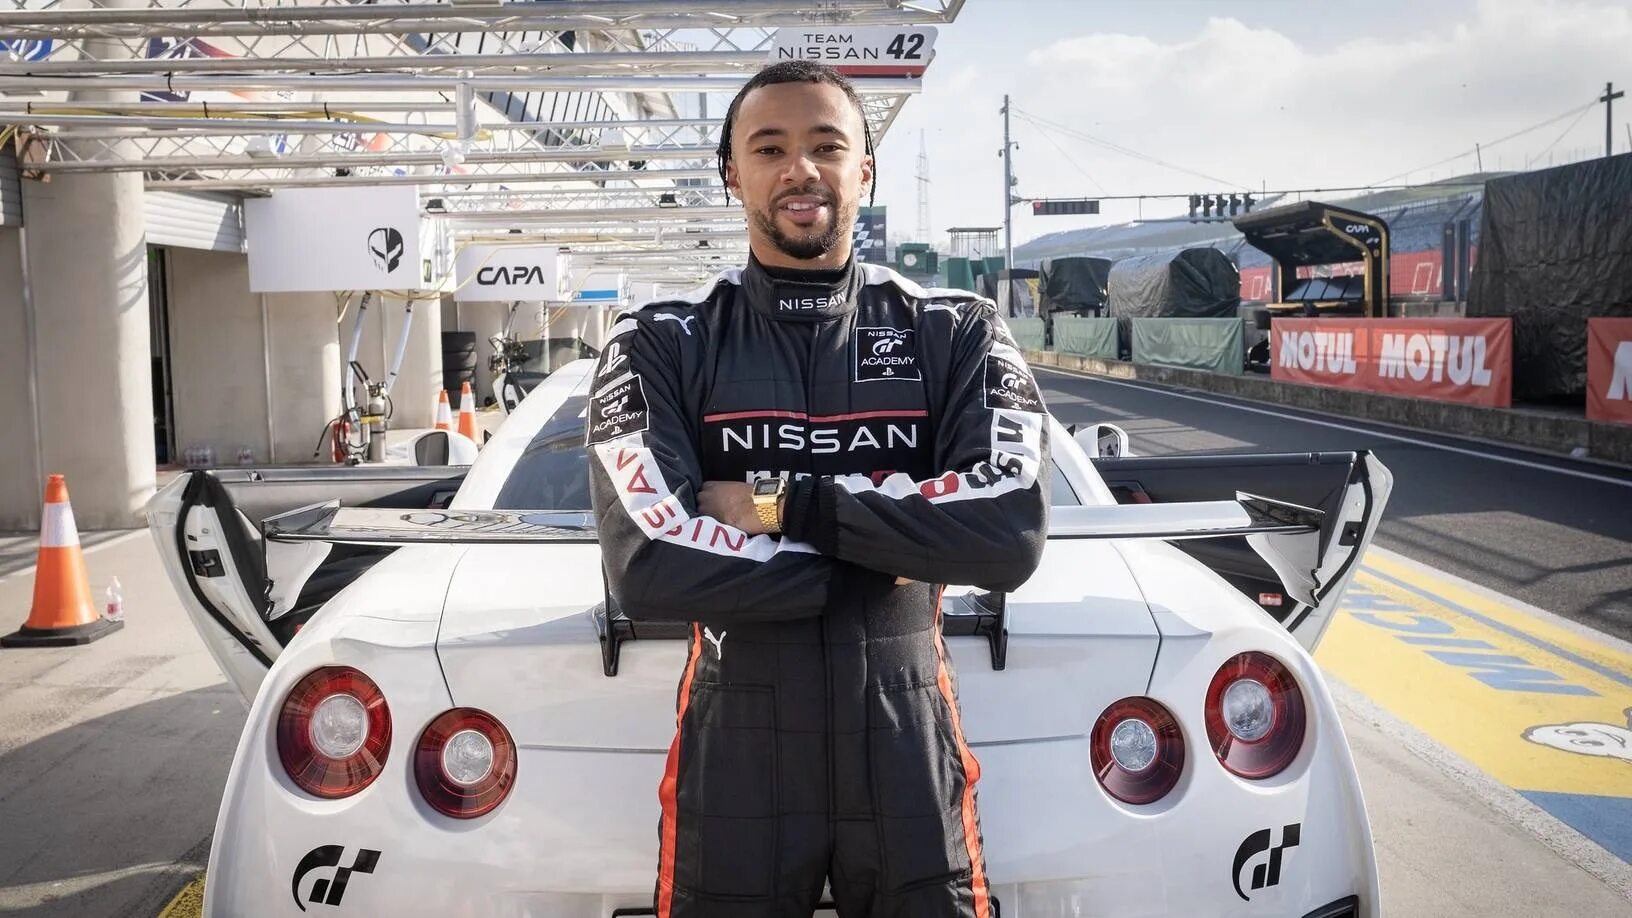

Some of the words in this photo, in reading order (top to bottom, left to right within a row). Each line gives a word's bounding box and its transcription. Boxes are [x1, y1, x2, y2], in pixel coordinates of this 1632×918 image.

[778, 47, 879, 59] NISSAN
[886, 33, 925, 60] 42
[803, 34, 853, 43] TEAM
[1345, 224, 1369, 233] CAPA
[476, 266, 545, 285] CAPA
[779, 292, 847, 311] NISSAN
[867, 331, 907, 340] NISSAN
[860, 356, 915, 367] ACADEMY
[1278, 329, 1357, 375] MOTUL
[1377, 333, 1493, 388] MOTUL
[599, 384, 632, 404] NISSAN
[990, 388, 1038, 406] ACADEMY
[592, 410, 643, 433] ACADEMY
[722, 424, 917, 454] NISSAN
